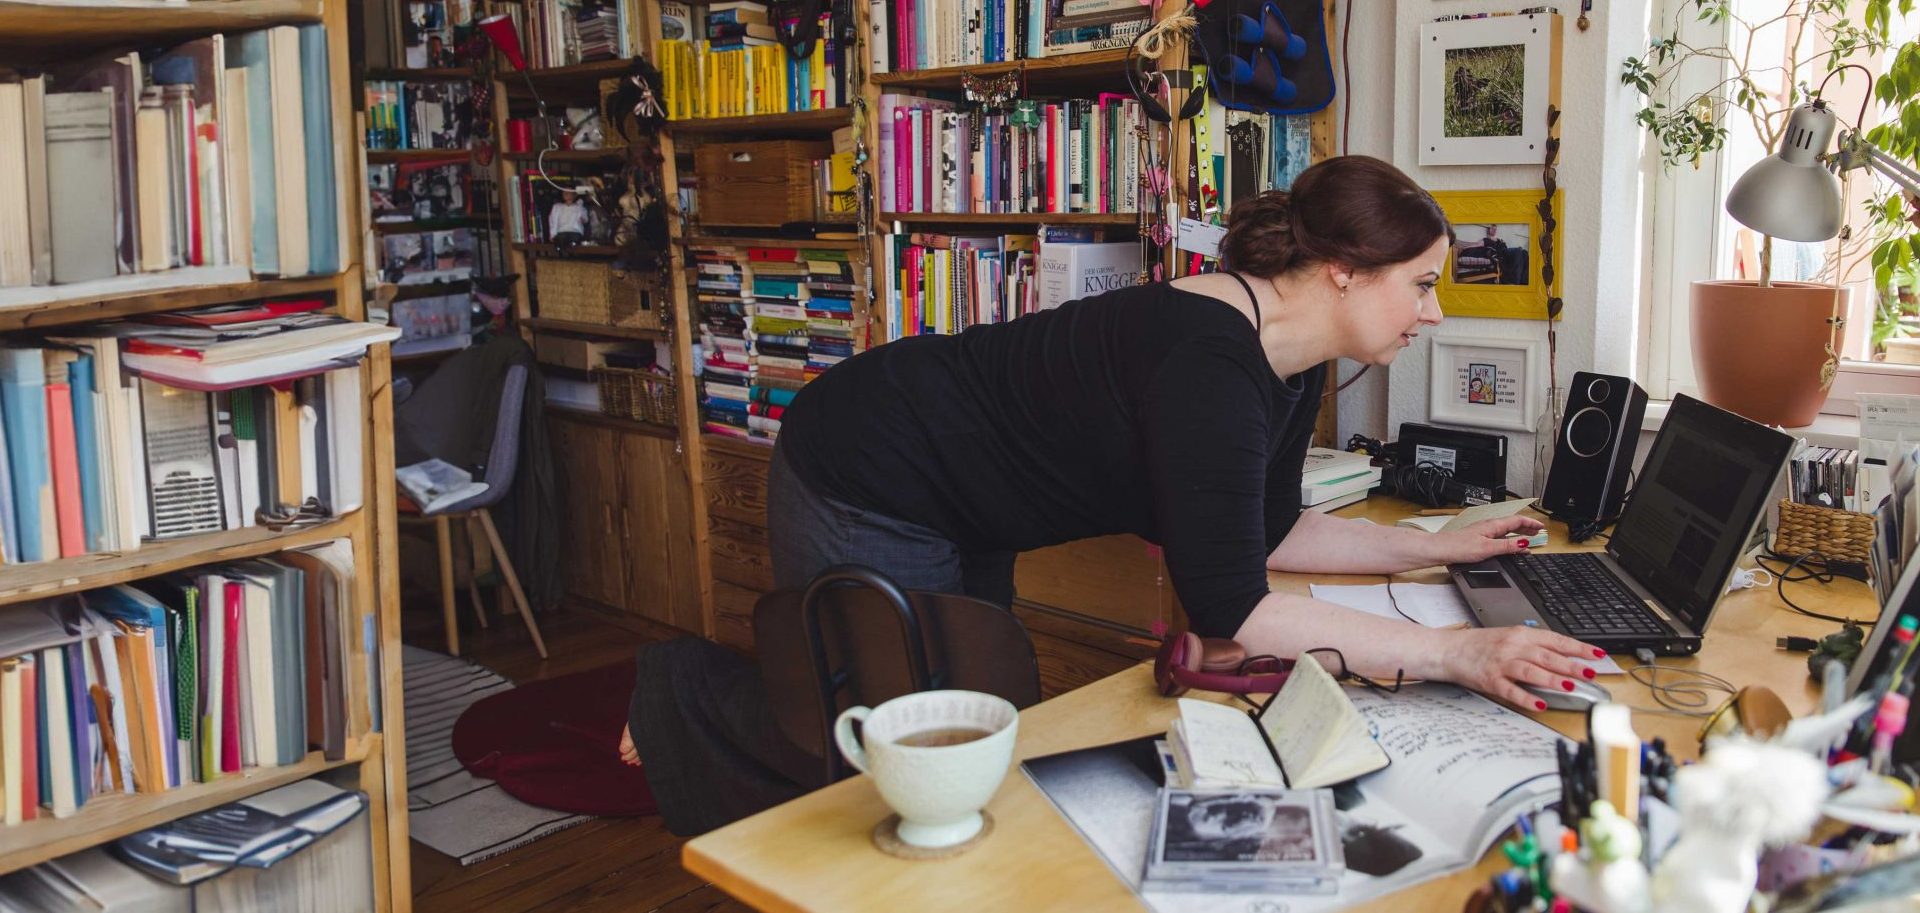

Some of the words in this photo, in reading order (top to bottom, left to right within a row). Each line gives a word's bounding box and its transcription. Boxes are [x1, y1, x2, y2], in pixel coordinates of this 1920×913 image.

[663, 7, 685, 17] RLIN
[1042, 261, 1069, 272] KNIGGE
[1084, 271, 1138, 293] KNIGGE
[1474, 368, 1490, 378] WIR
